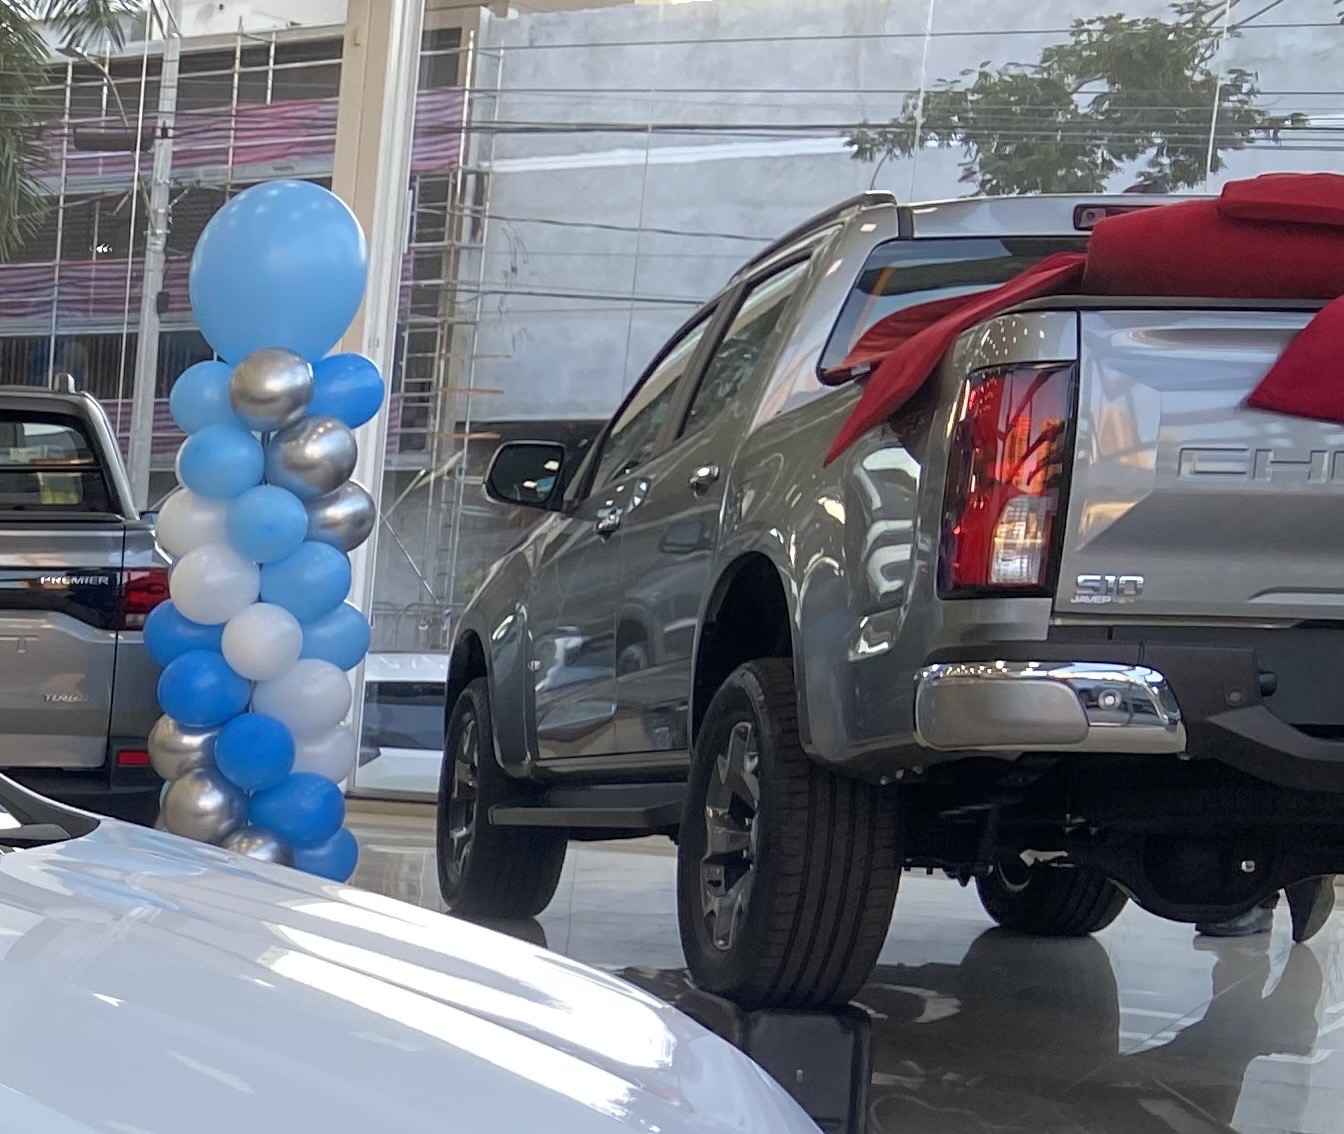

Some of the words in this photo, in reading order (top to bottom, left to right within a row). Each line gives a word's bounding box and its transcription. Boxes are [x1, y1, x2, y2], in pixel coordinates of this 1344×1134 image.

[1178, 447, 1344, 485] CH
[40, 575, 109, 586] PREMIER
[1075, 573, 1144, 596] S10
